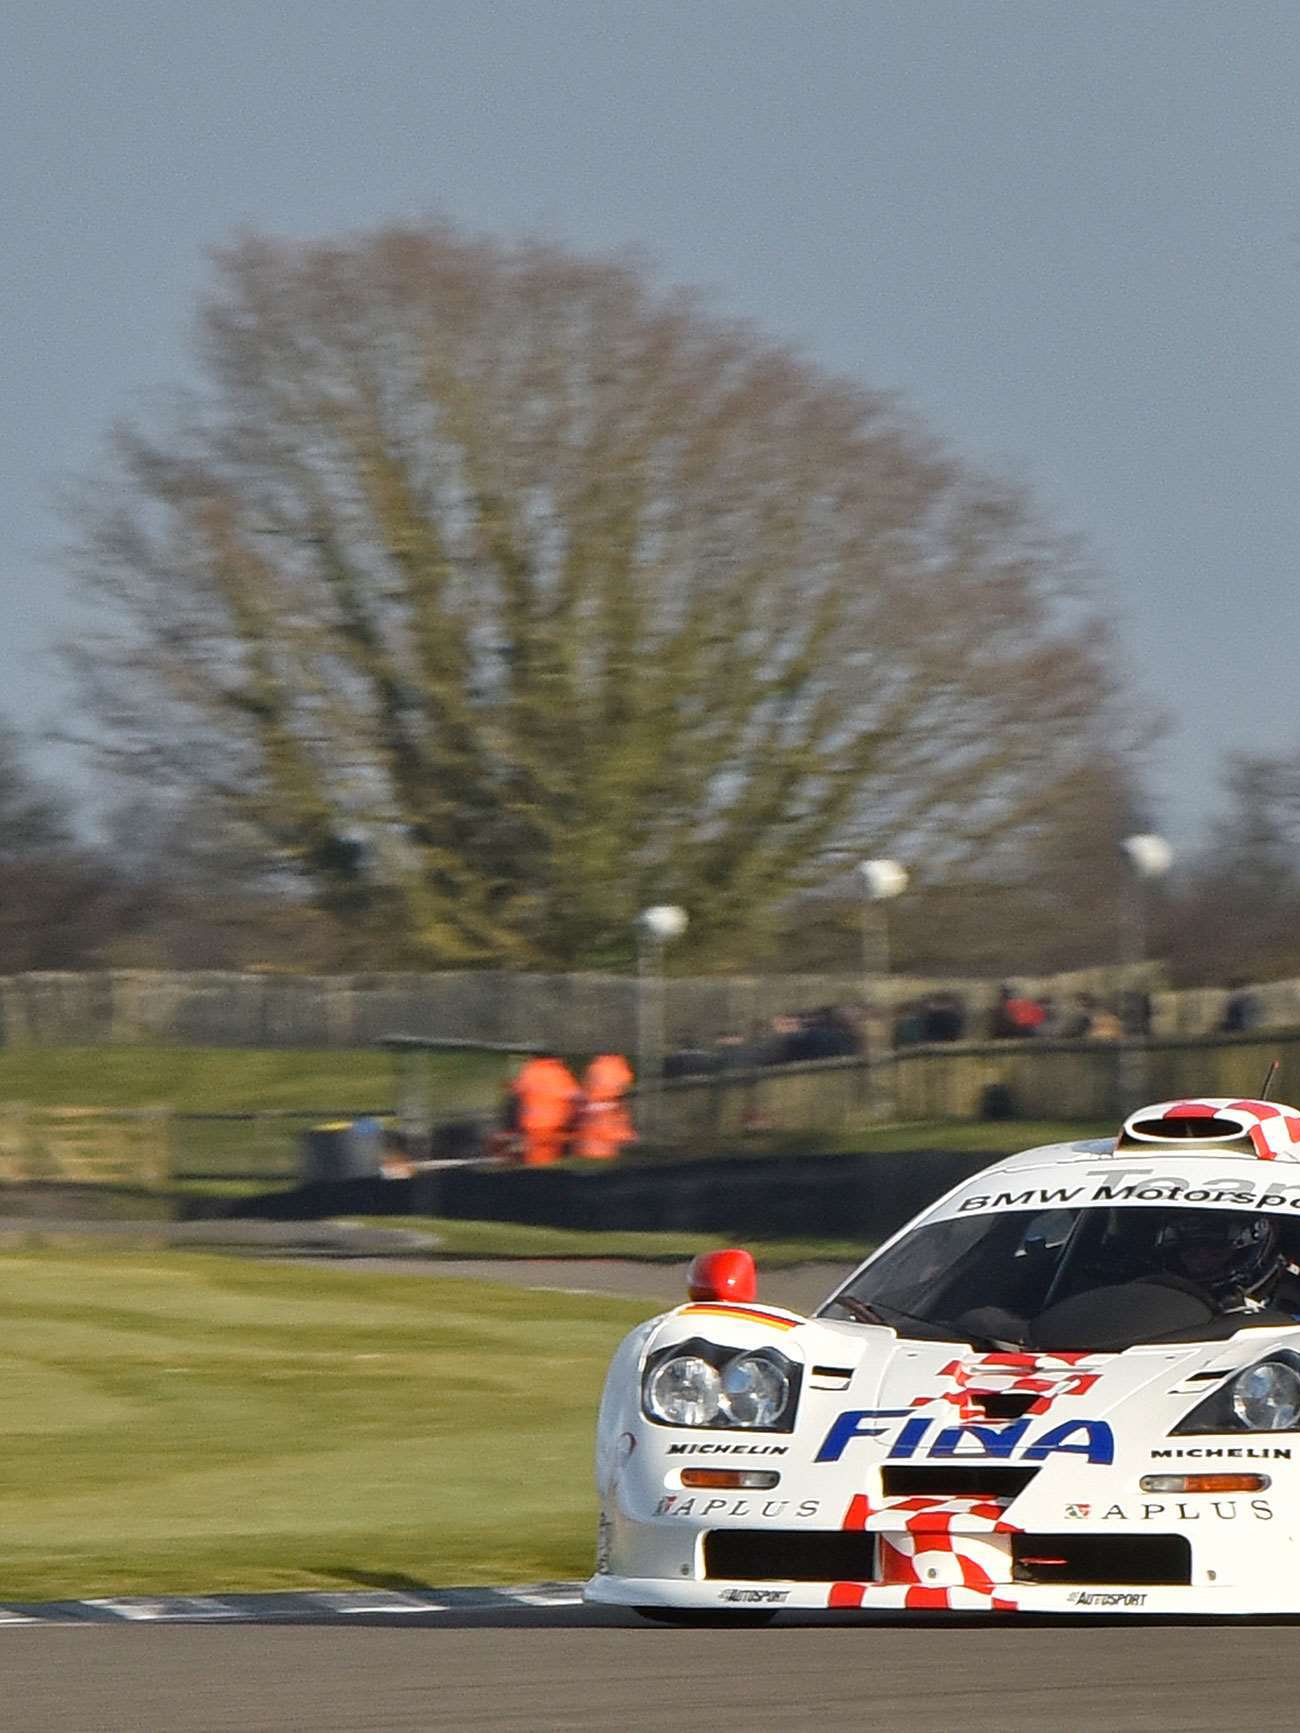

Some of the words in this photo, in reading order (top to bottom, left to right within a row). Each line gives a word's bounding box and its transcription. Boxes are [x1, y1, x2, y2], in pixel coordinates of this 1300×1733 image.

[959, 1187, 1086, 1212] BMW
[813, 1409, 1115, 1465] FINA
[666, 1444, 789, 1455] MICHELIN
[1151, 1448, 1292, 1460] MICHELIN
[672, 1498, 820, 1518] APLUS
[1101, 1499, 1274, 1520] APLUS
[1076, 1592, 1148, 1606] AUTOSPORT
